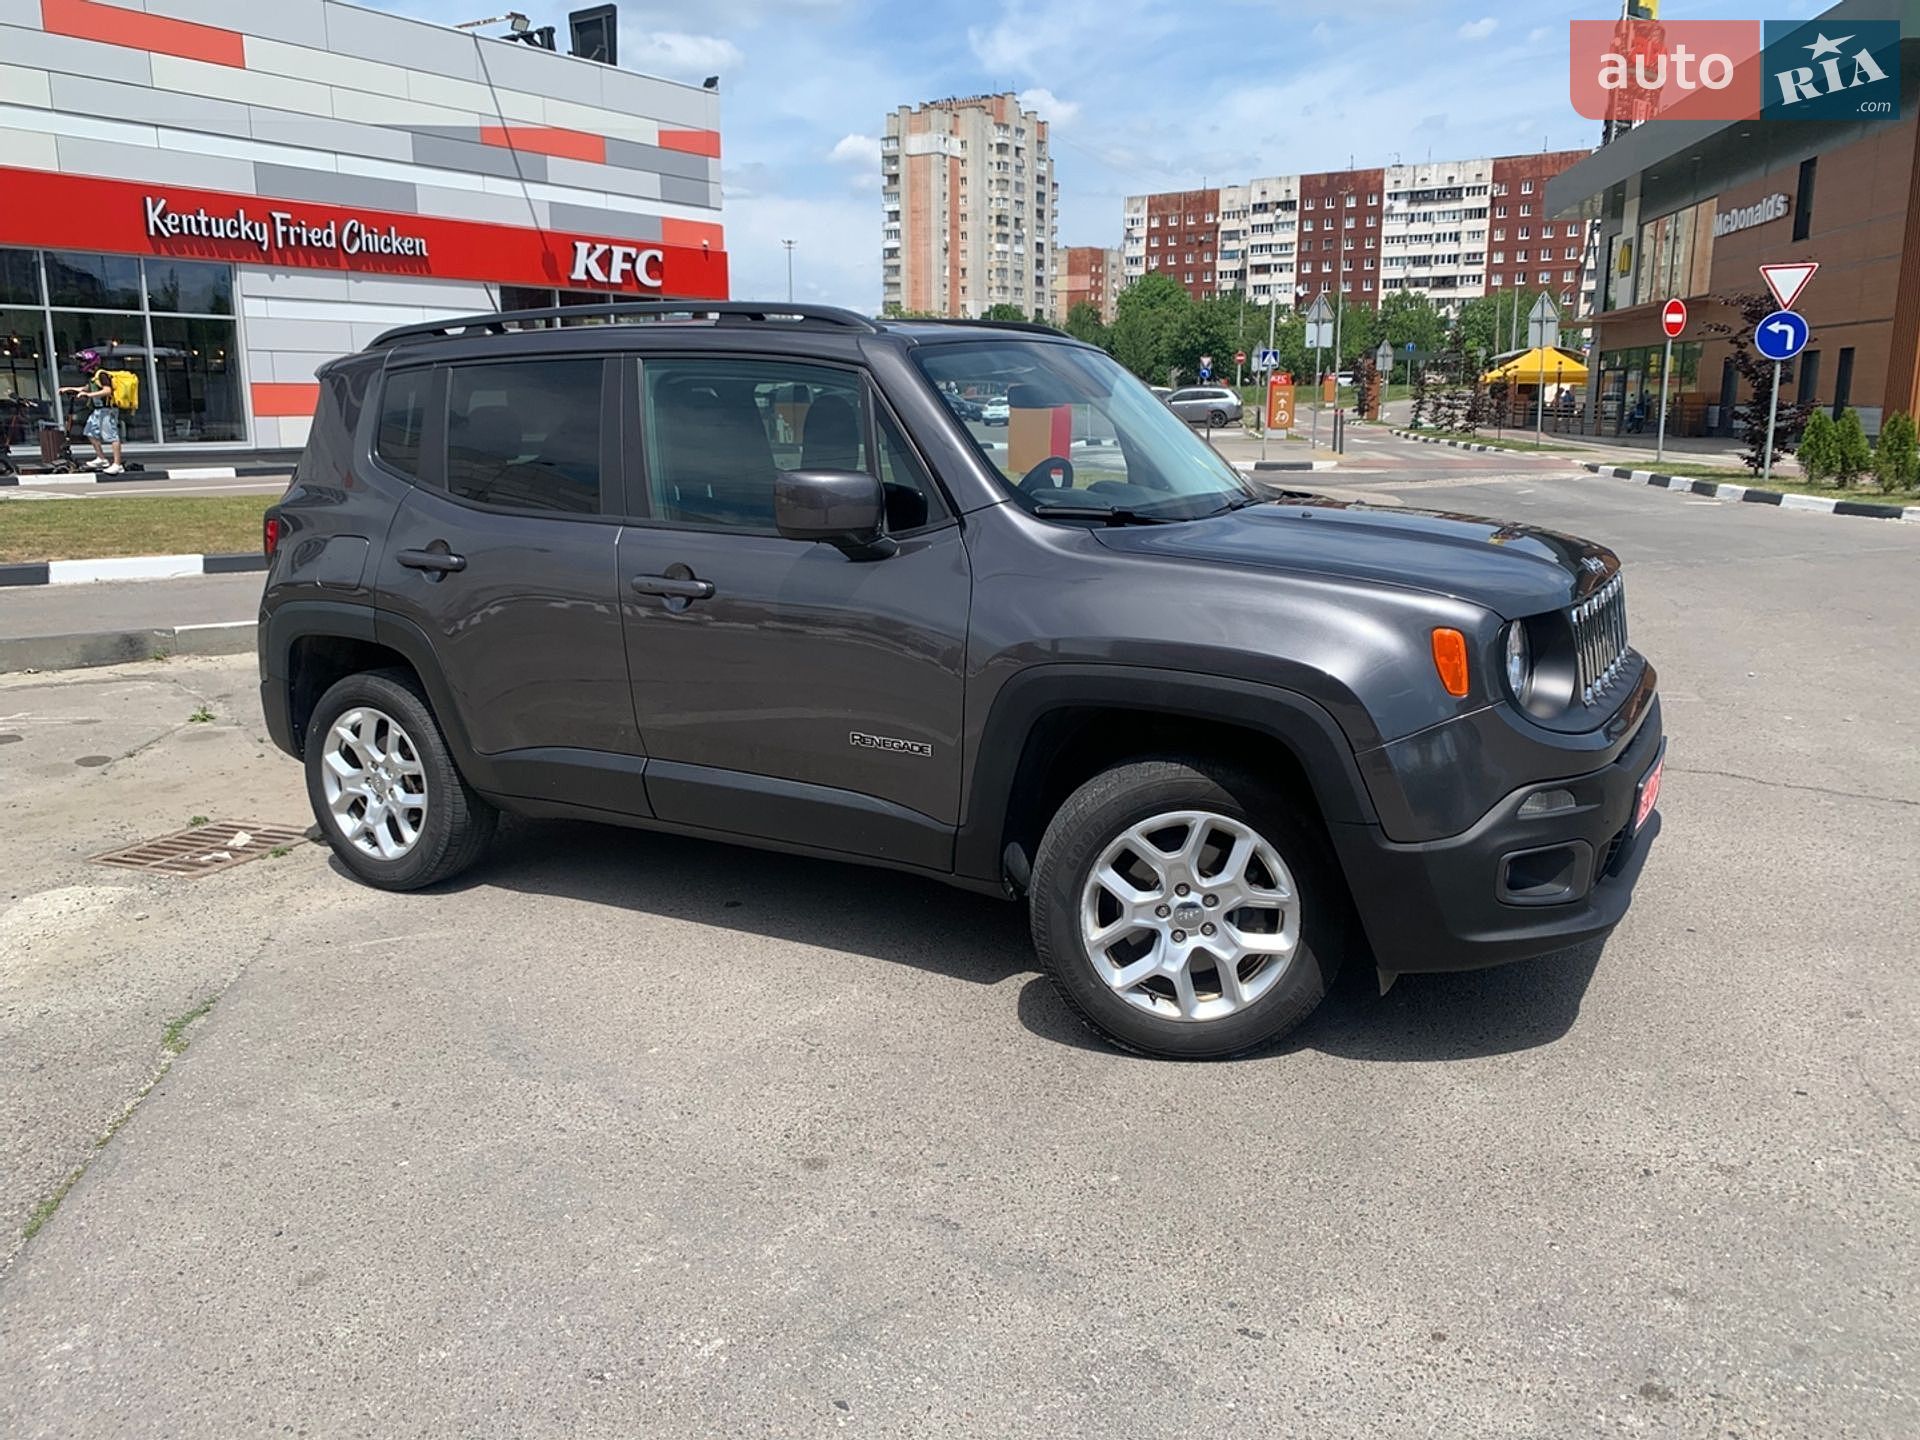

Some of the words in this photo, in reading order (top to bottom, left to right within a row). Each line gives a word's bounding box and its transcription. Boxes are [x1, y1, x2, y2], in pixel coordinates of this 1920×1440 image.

[145, 197, 269, 251] Kentucky
[271, 212, 337, 249] Fried
[342, 219, 429, 256] Chicken
[570, 241, 664, 287] KFC
[849, 731, 933, 757] RENEGADE
